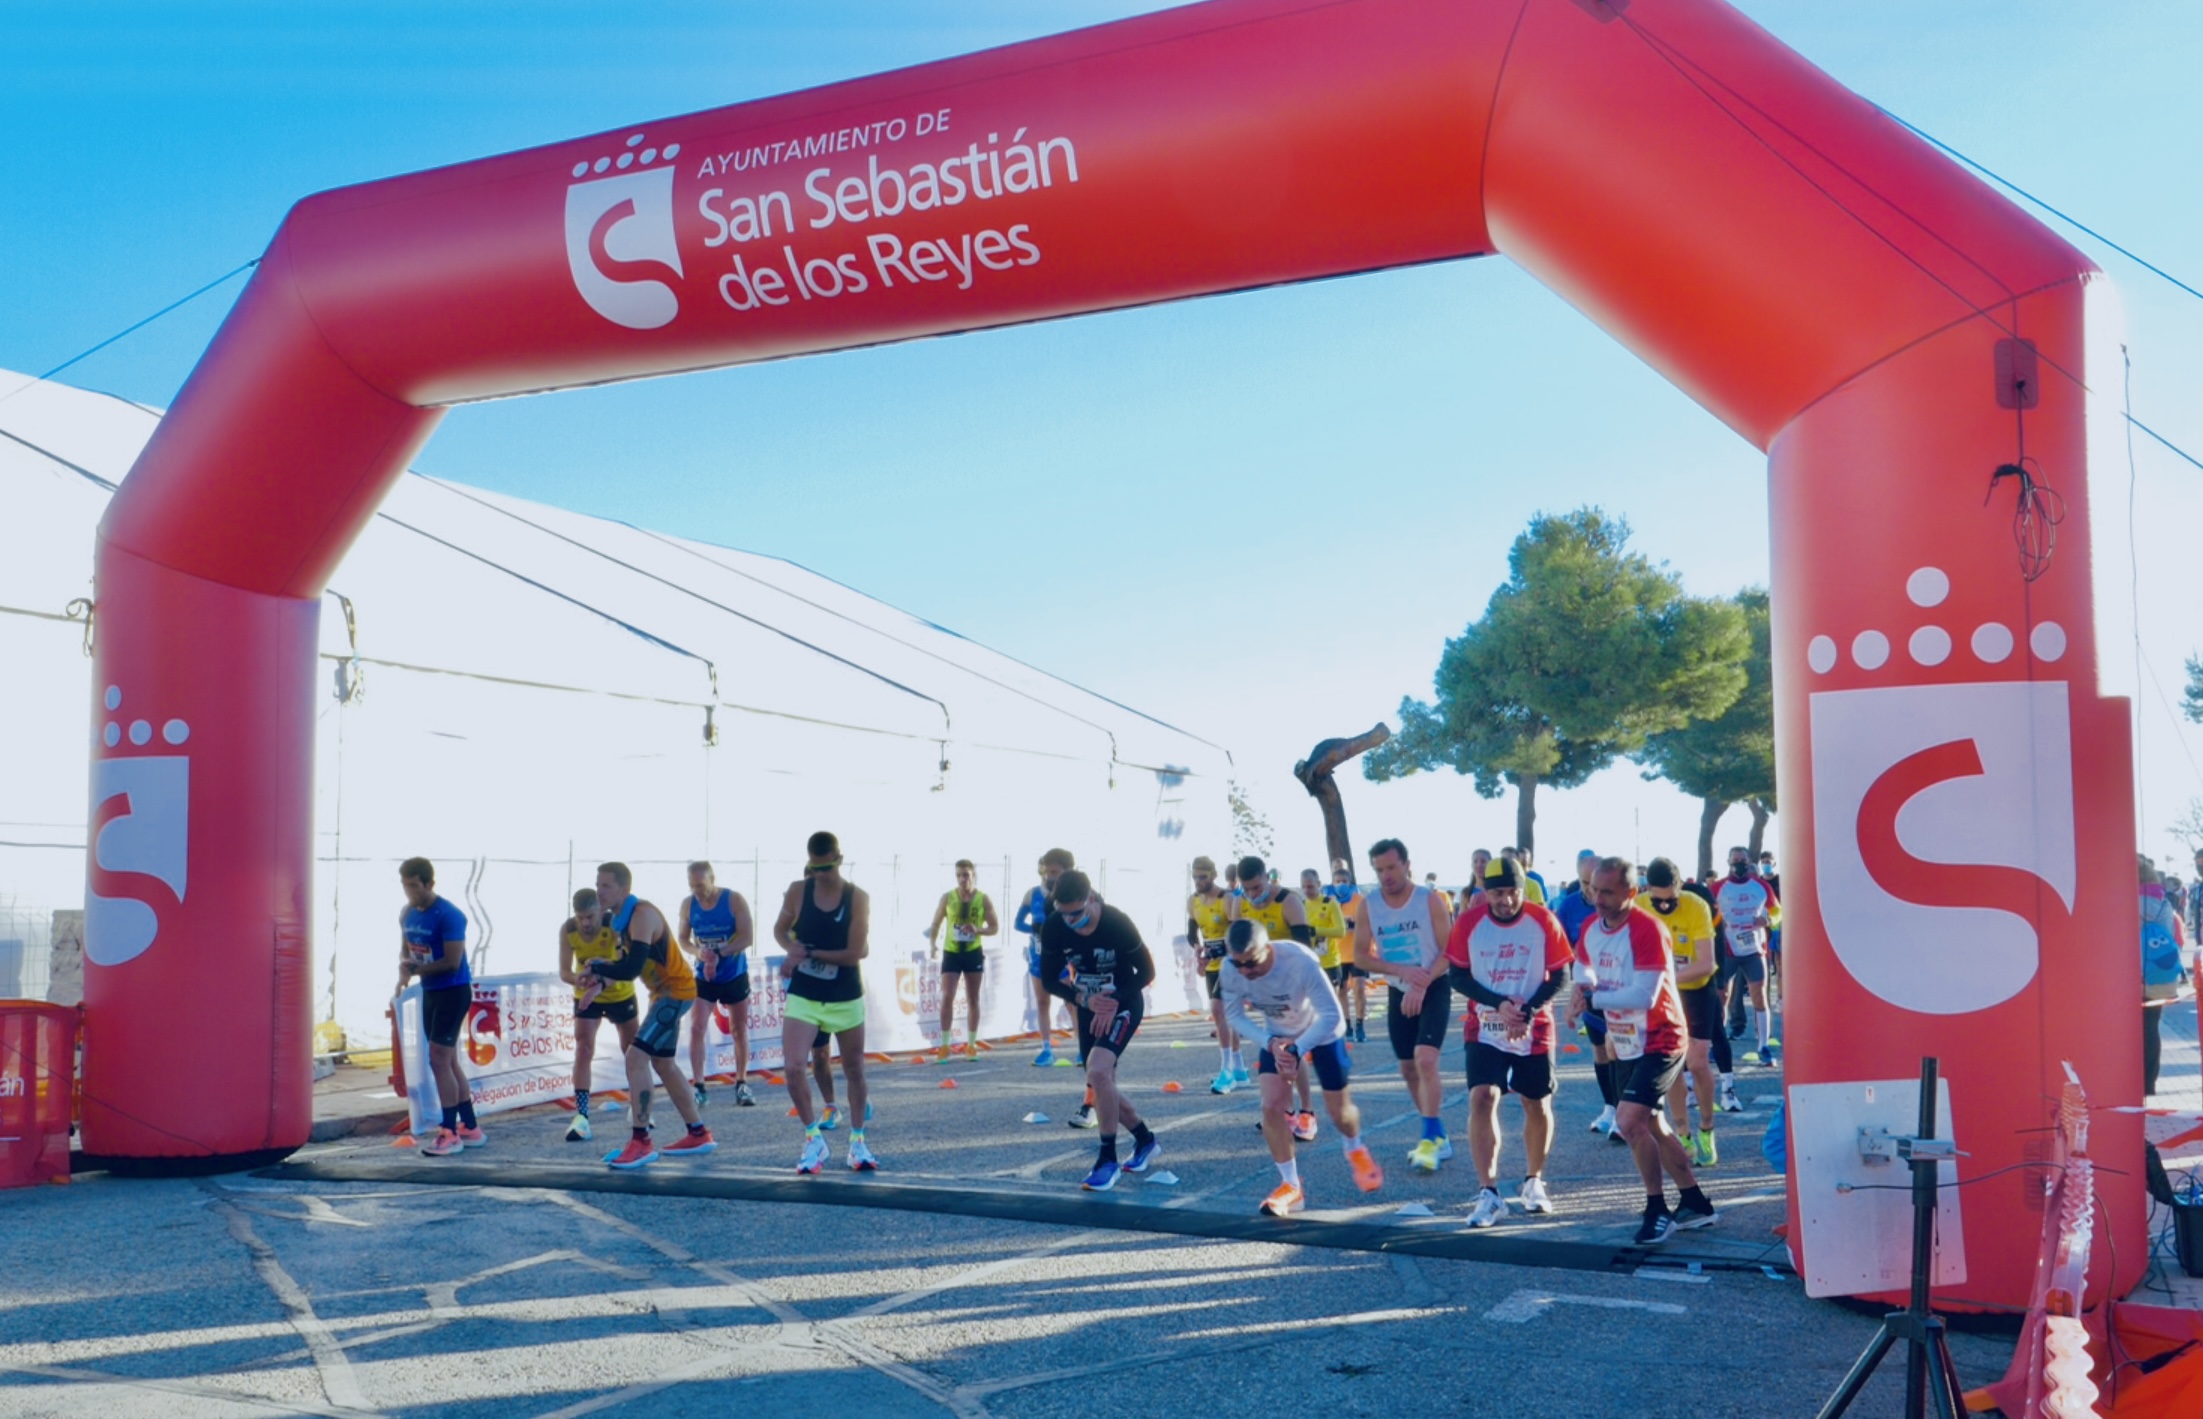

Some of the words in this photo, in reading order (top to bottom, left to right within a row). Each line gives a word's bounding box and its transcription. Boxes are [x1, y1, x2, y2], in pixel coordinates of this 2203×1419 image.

[697, 118, 907, 179] AYUNTAMIENTO
[914, 108, 952, 137] DE
[698, 187, 795, 247] San
[803, 126, 1079, 228] Sebastián
[717, 253, 790, 311] de
[782, 244, 869, 300] los
[866, 222, 1041, 290] Reyes
[1378, 920, 1420, 936] AAYA
[509, 1036, 531, 1058] de
[532, 1033, 553, 1055] los
